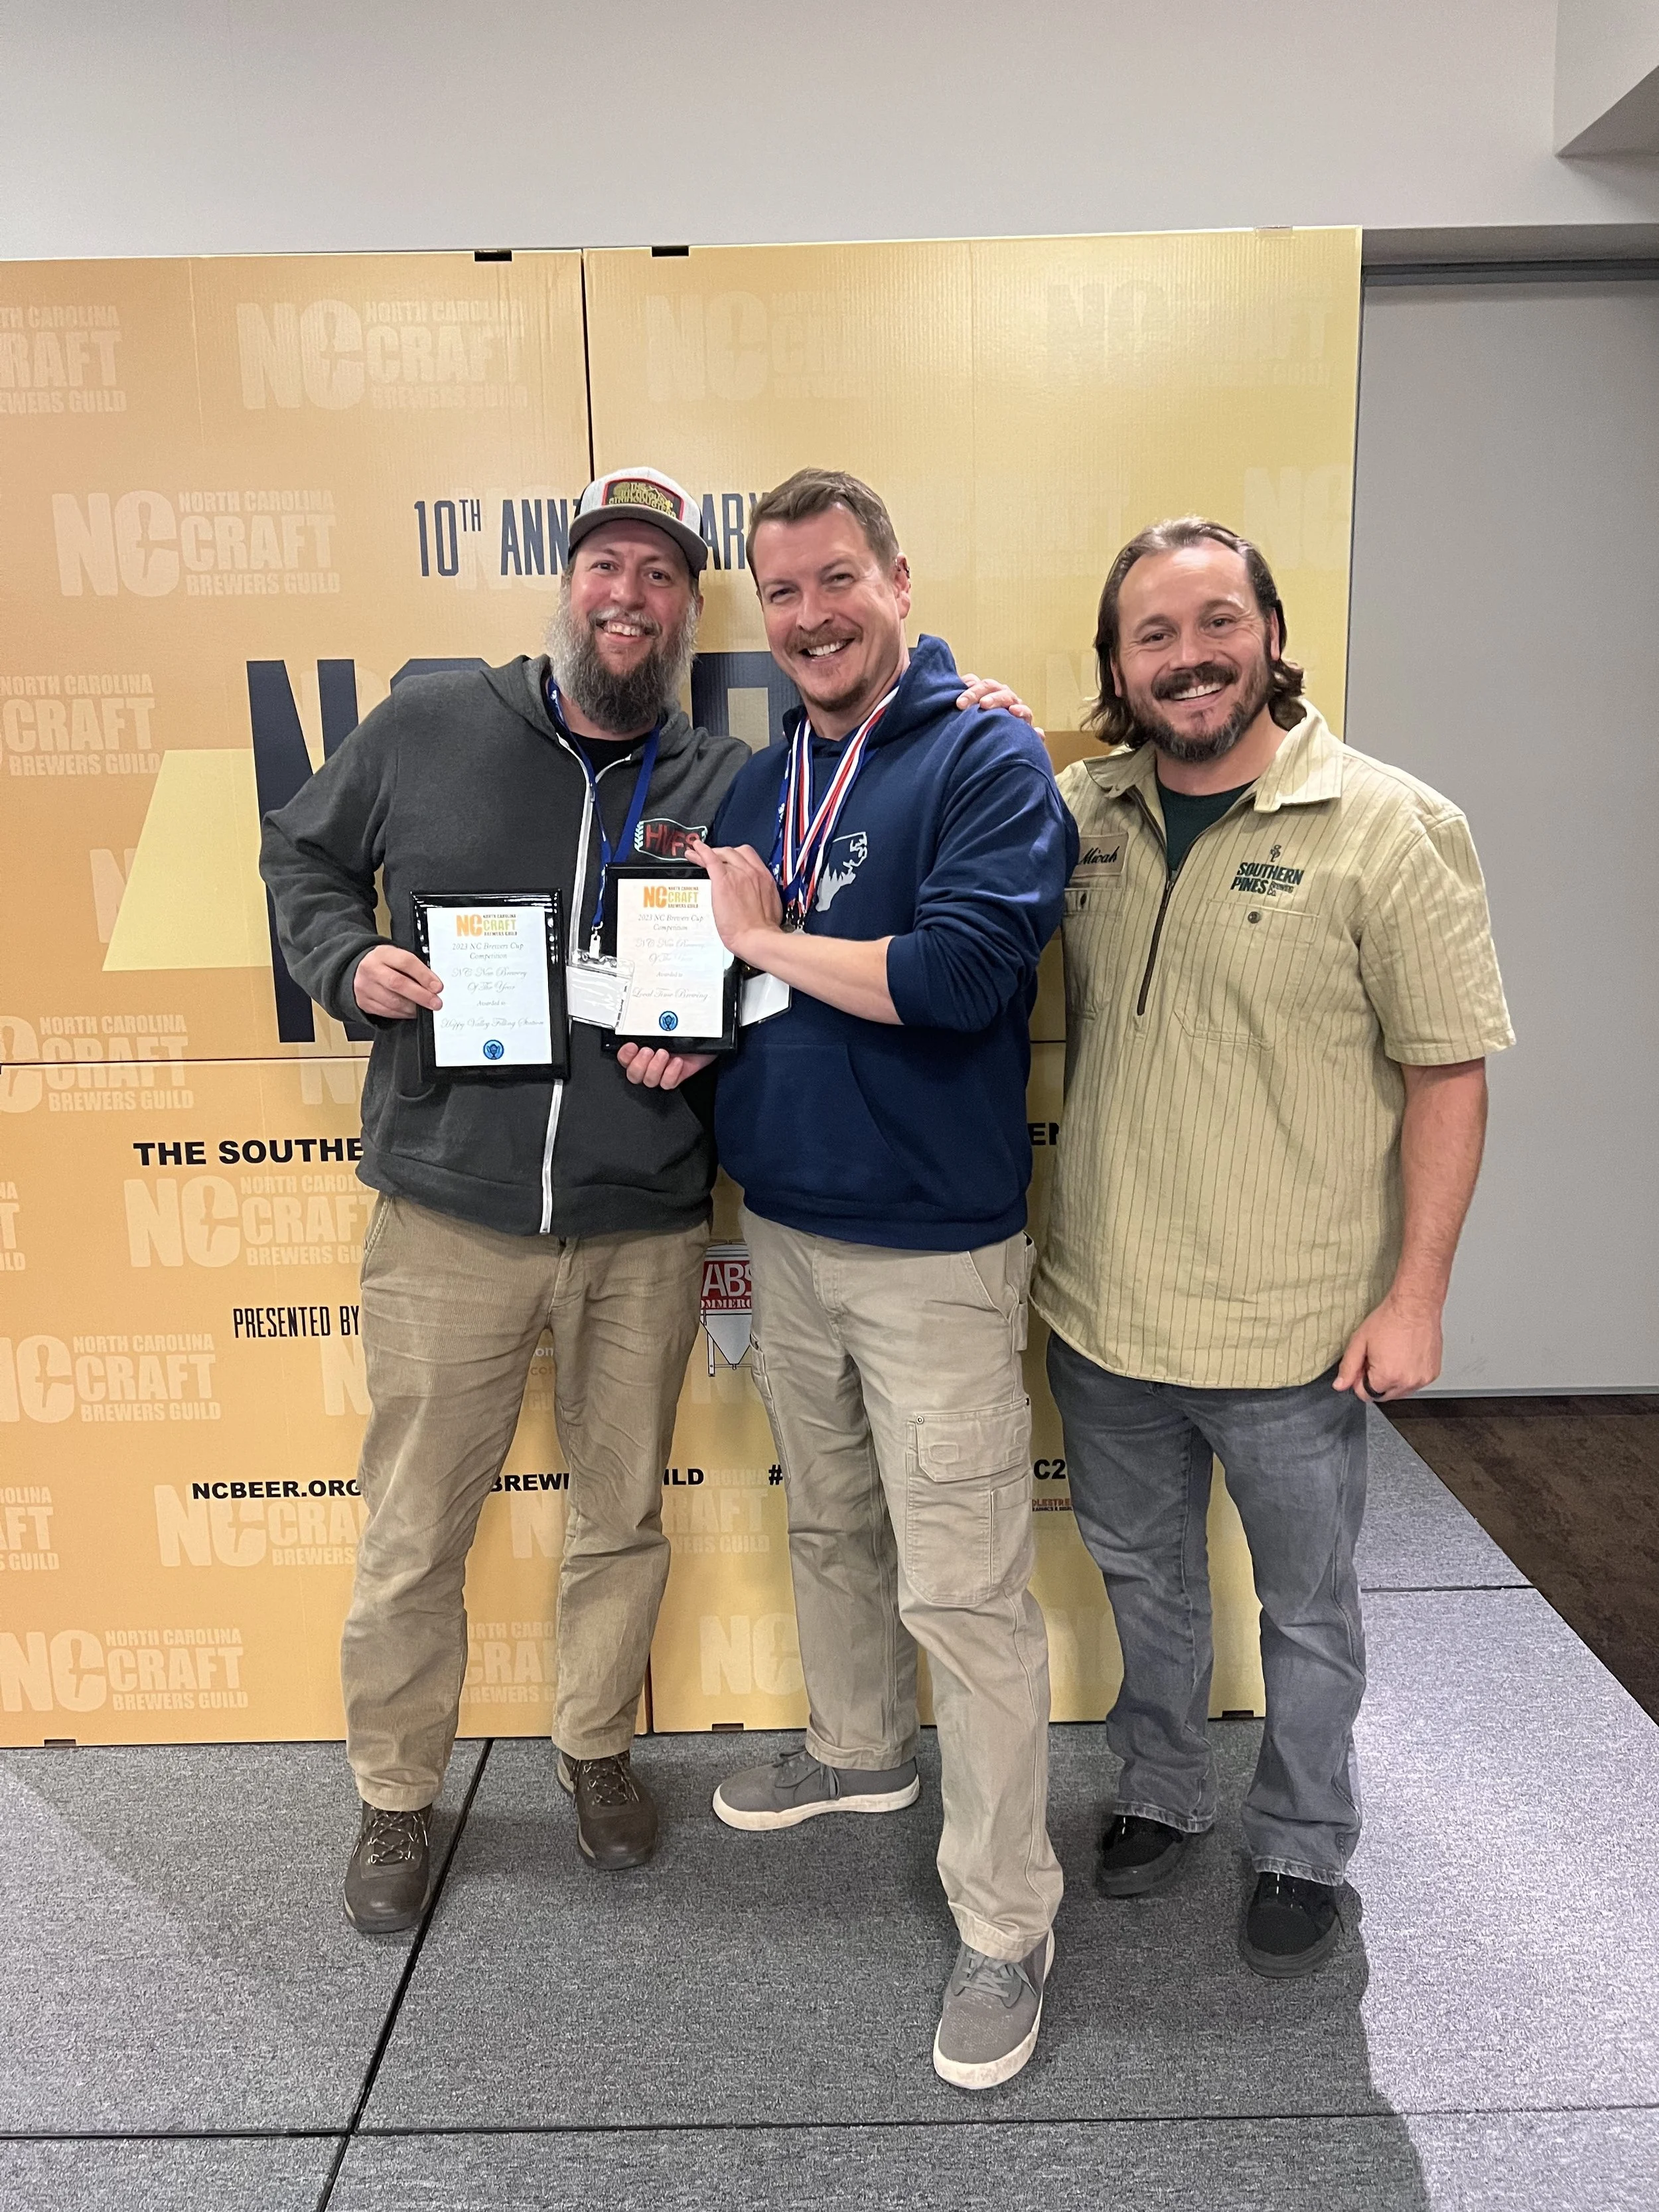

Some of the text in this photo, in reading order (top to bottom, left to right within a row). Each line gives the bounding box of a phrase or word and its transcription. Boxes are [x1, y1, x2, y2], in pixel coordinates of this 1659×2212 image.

[28, 305, 121, 328] CAROLINA
[364, 301, 427, 323] NORTH
[0, 331, 123, 388] RAFT
[236, 299, 365, 410] NC
[366, 325, 525, 384] CRAFT
[68, 390, 127, 413] GUILD
[178, 490, 336, 513] NORTH CAROLINA
[52, 490, 180, 597] NC
[180, 514, 336, 571] CRAFT
[186, 572, 341, 596] BREWERS GUILD
[0, 674, 154, 696] NORTH CAROLINA
[3, 698, 155, 753] CRAFT
[9, 753, 161, 776] BREWERS GUILD
[1080, 846, 1120, 865] Micah
[1237, 862, 1305, 885] SOUTHERN
[644, 885, 668, 909] NC
[668, 891, 699, 903] CRAFT
[1230, 877, 1269, 894] PINES
[456, 914, 482, 936] NC
[483, 919, 517, 930] CRAFT
[691, 914, 704, 922] Cup
[510, 942, 524, 950] Cup
[39, 1014, 188, 1035] NORTH CAROLINA
[41, 1035, 188, 1090] CRAFT
[48, 1089, 194, 1112] BREWERS GUILD
[132, 1138, 363, 1167] THE SOUTHE
[240, 1175, 297, 1195] NORTH
[123, 1175, 241, 1268] NC
[246, 1245, 333, 1266] BREWERS
[233, 1305, 360, 1339] PRESENTED BY
[72, 1333, 215, 1353] NORTH CAROLINA
[75, 1354, 216, 1402] CRAFT
[80, 1402, 222, 1422] BREWERS GUILD
[192, 1480, 363, 1501] NCBEER.ORG
[663, 1488, 769, 1534] RAFT
[267, 1500, 369, 1547] CRA
[719, 1534, 770, 1553] GUILD
[8, 1552, 60, 1570] GUILD
[272, 1547, 356, 1567] BREWERS
[105, 1628, 243, 1647] NORTH CAROLINA
[0, 1629, 107, 1712] NC
[107, 1646, 244, 1692] CRAFT
[113, 1691, 249, 1711] BREWERS GUILD
